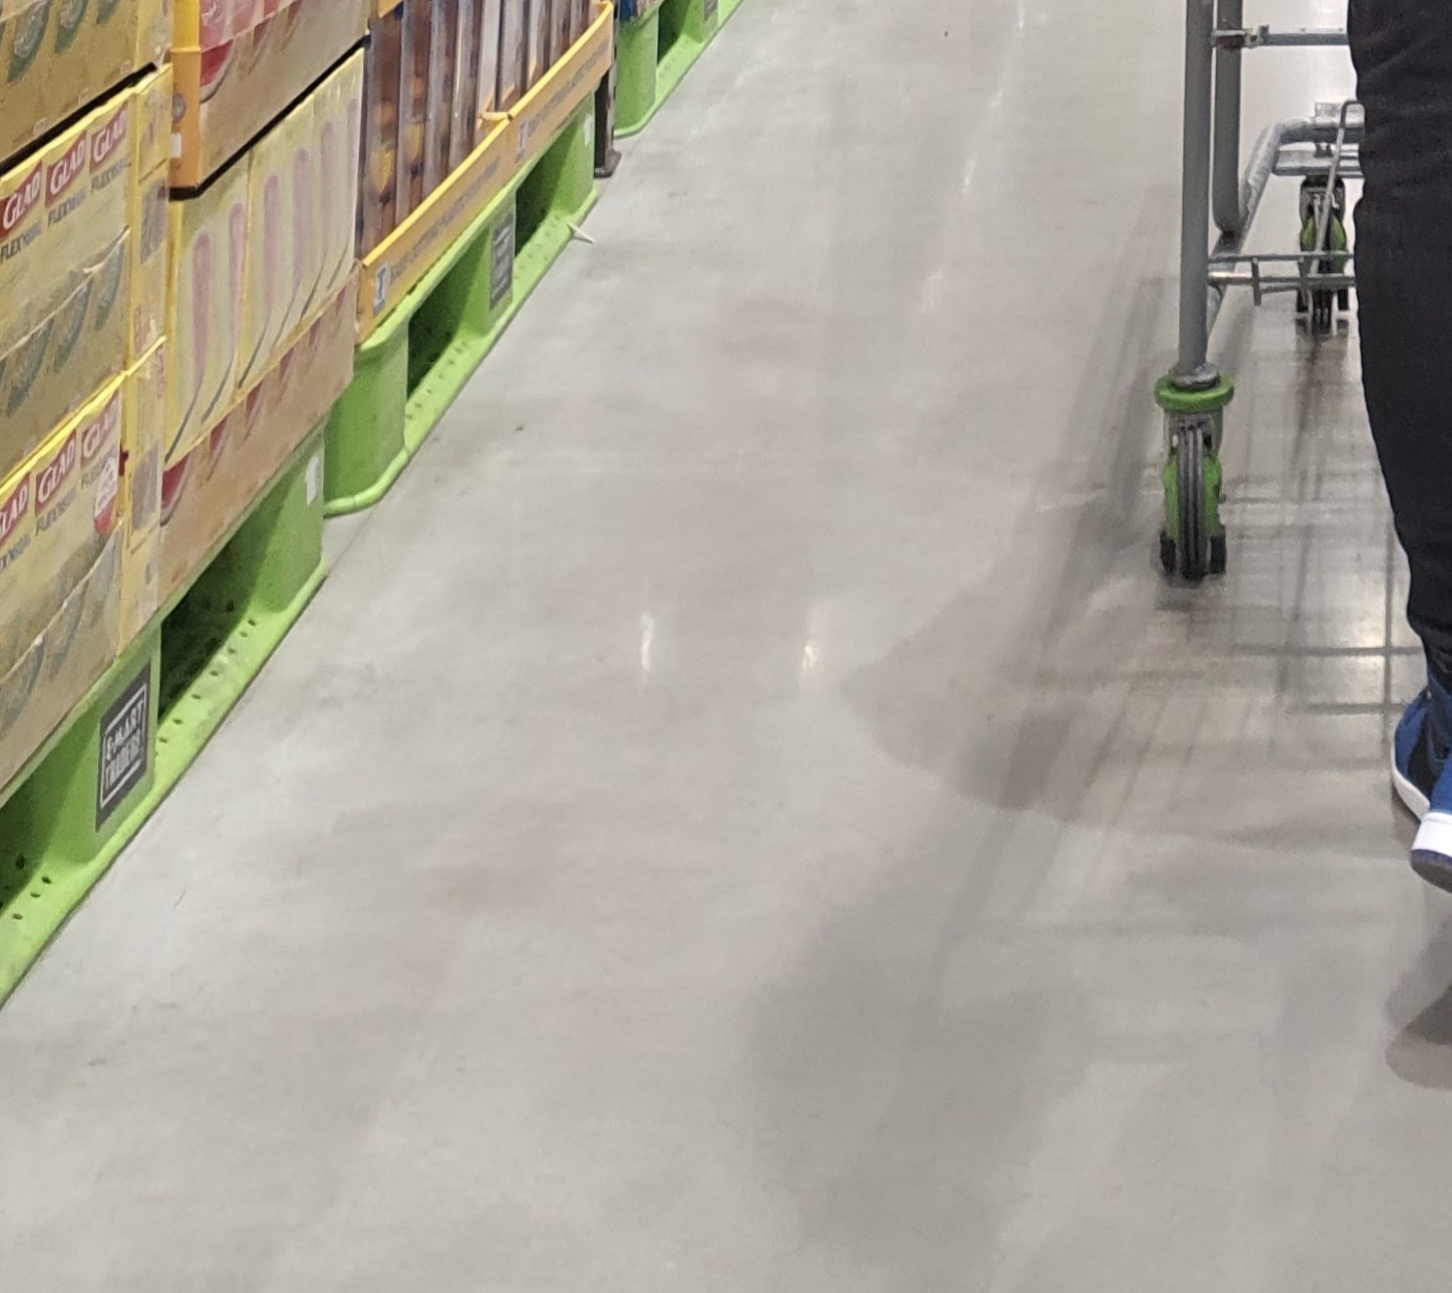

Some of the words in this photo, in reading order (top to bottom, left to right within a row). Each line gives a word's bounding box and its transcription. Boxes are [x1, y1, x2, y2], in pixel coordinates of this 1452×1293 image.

[51, 139, 86, 196] GLAD
[3, 169, 41, 230] GLAD
[38, 437, 75, 505] GLAD
[0, 483, 29, 540] LAD
